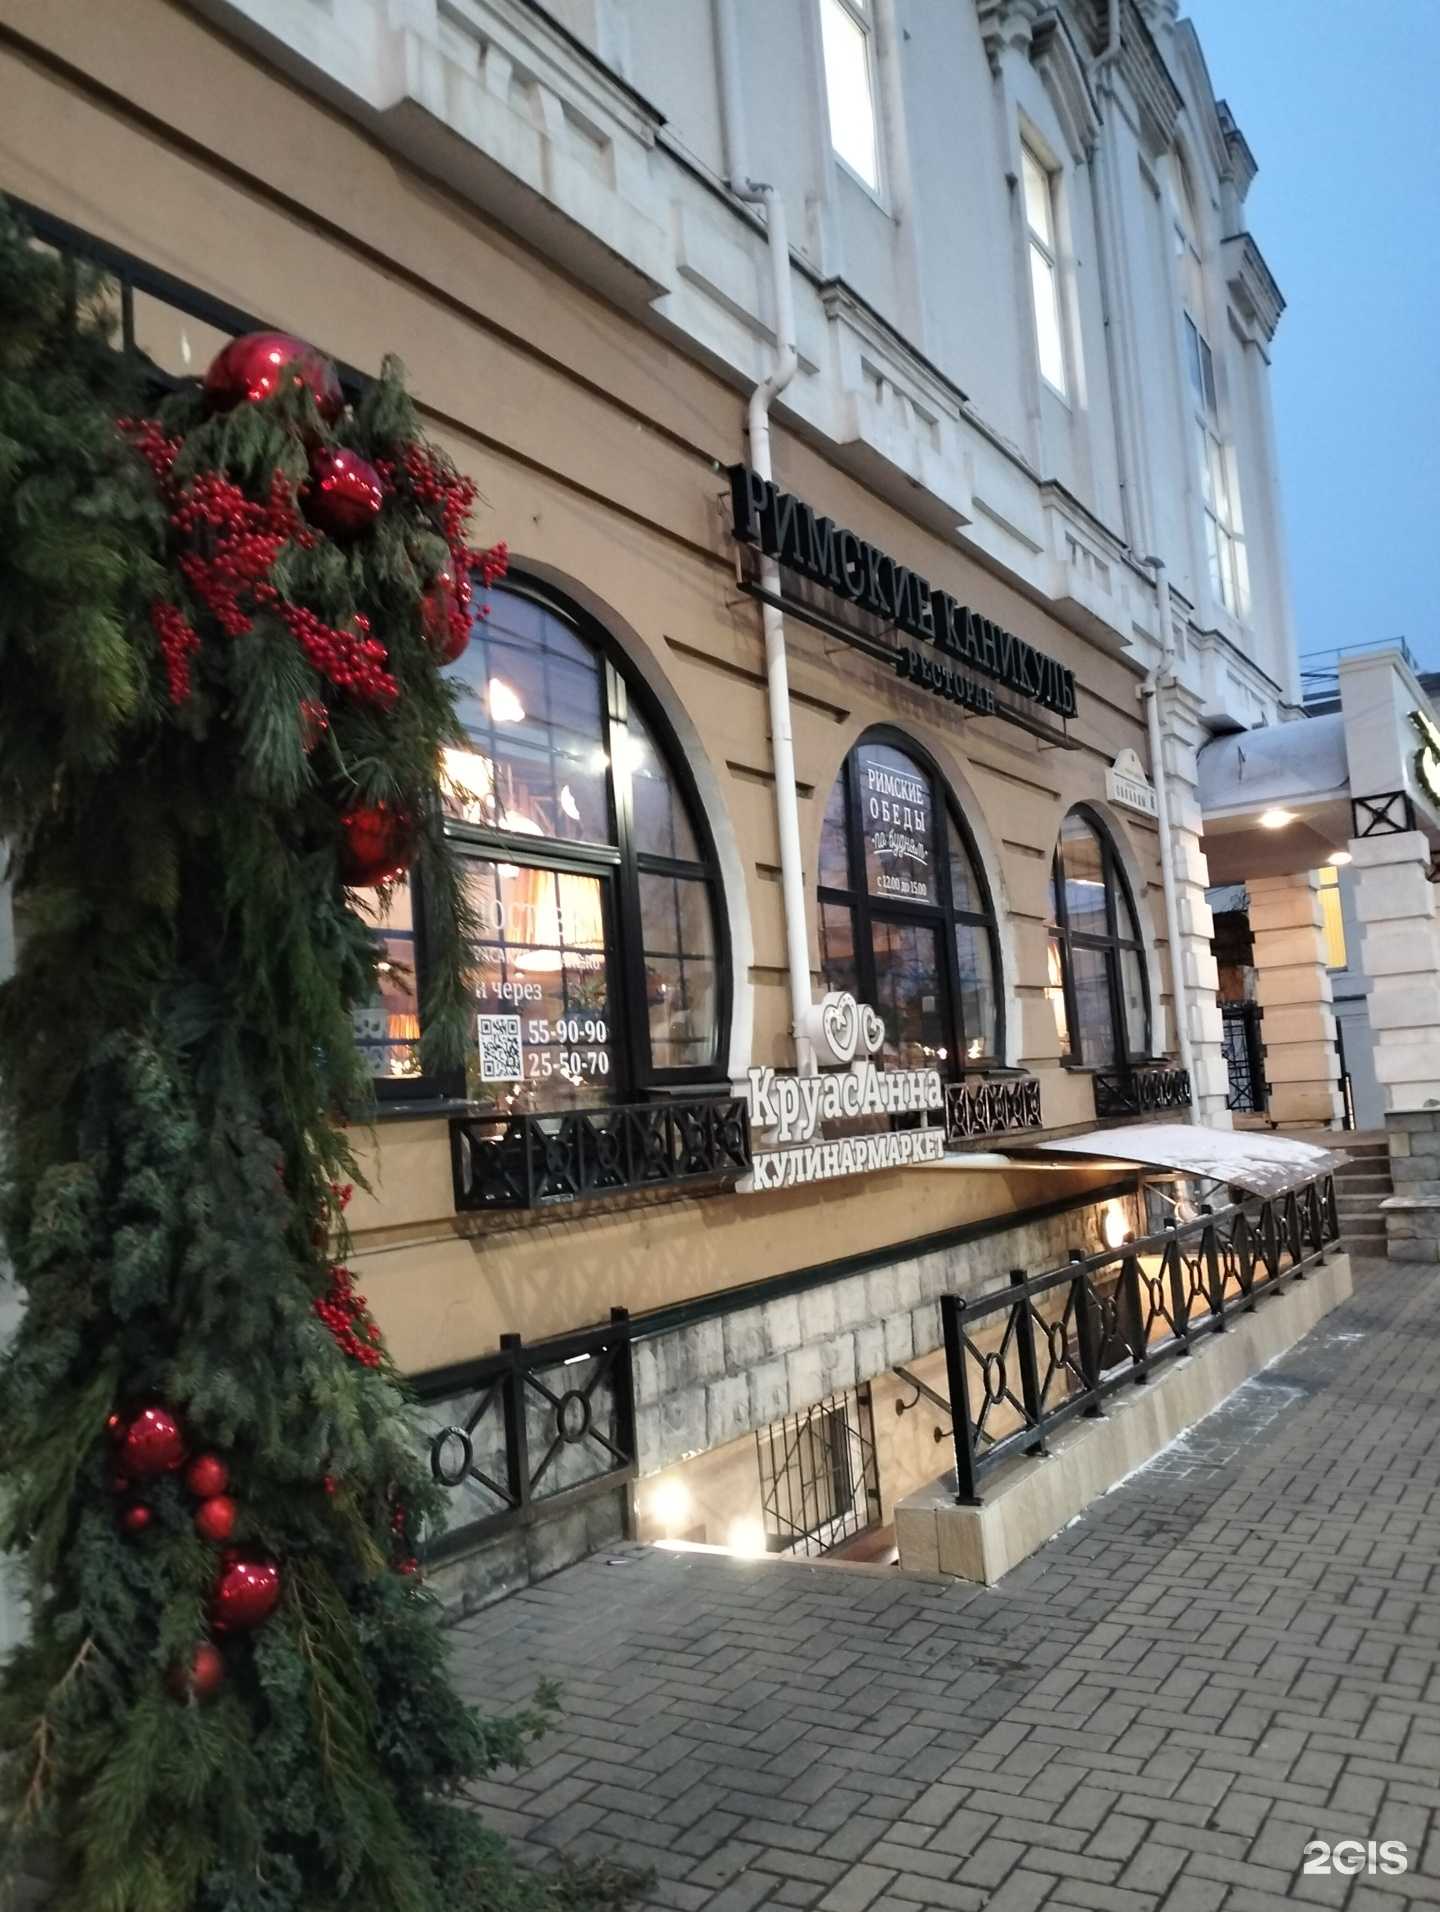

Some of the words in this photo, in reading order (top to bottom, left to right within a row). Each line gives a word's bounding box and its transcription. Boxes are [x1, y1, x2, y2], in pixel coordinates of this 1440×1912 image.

[731, 464, 936, 640] РИМСКИЕ
[901, 648, 996, 716] РЕСТОРАН
[867, 768, 924, 804] РИМСКИЕ
[869, 797, 926, 832] ОБЕДЫ
[492, 980, 543, 1005] через
[528, 1019, 608, 1044] 55-90-90
[528, 1051, 610, 1077] 25-50-70
[747, 1062, 944, 1144] КруасАнна
[752, 1129, 946, 1192] КУЛИНАРМАРКЕТ
